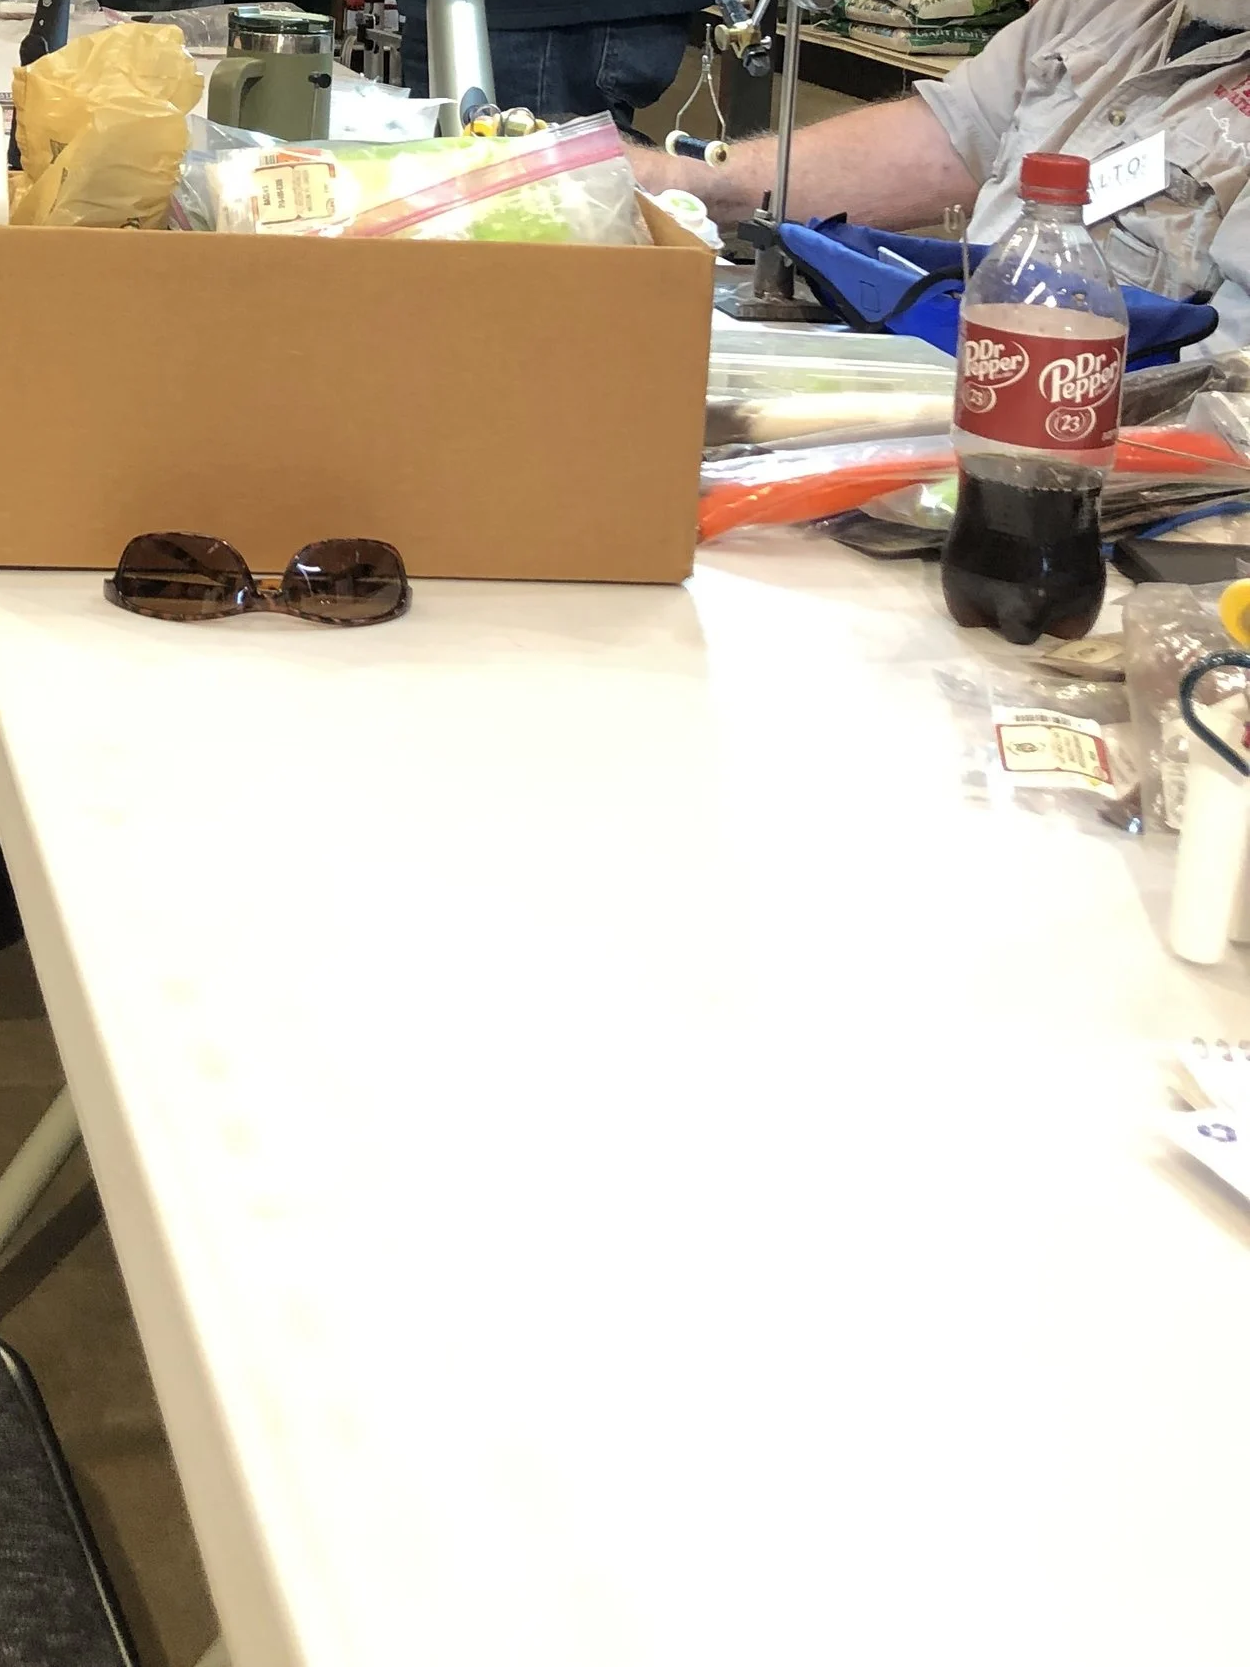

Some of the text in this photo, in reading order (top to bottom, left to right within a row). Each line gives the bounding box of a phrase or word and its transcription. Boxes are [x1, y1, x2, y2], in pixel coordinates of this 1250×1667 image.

[982, 339, 1006, 359] Dr
[1076, 353, 1107, 378] Dr
[1050, 358, 1119, 404] Pepper
[1061, 415, 1080, 433] 23
